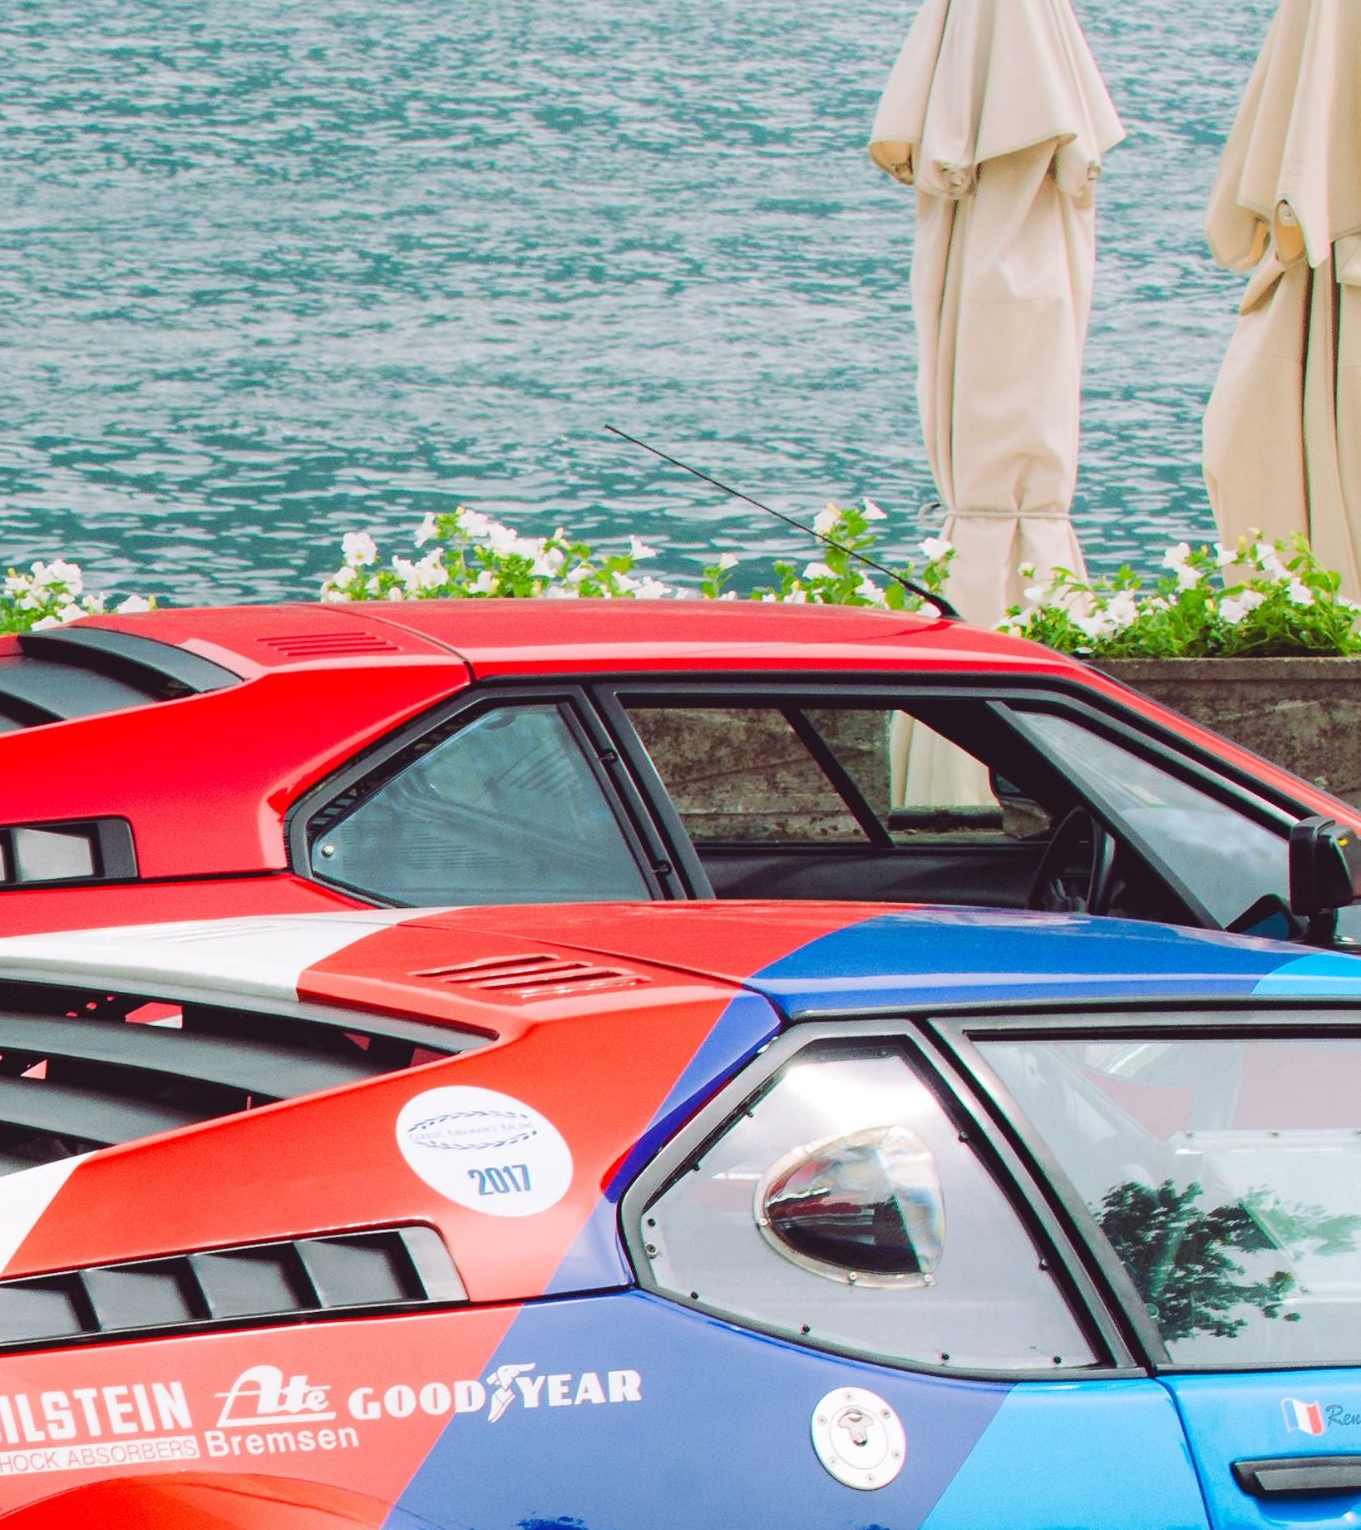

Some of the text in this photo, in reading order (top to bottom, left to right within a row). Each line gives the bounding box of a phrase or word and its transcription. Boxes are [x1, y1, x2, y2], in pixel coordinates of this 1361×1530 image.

[467, 1163, 533, 1196] 2017
[347, 1362, 643, 1424] GOODYEAR
[66, 1438, 199, 1469] ABSORBERS
[204, 1426, 360, 1459] Bremsen
